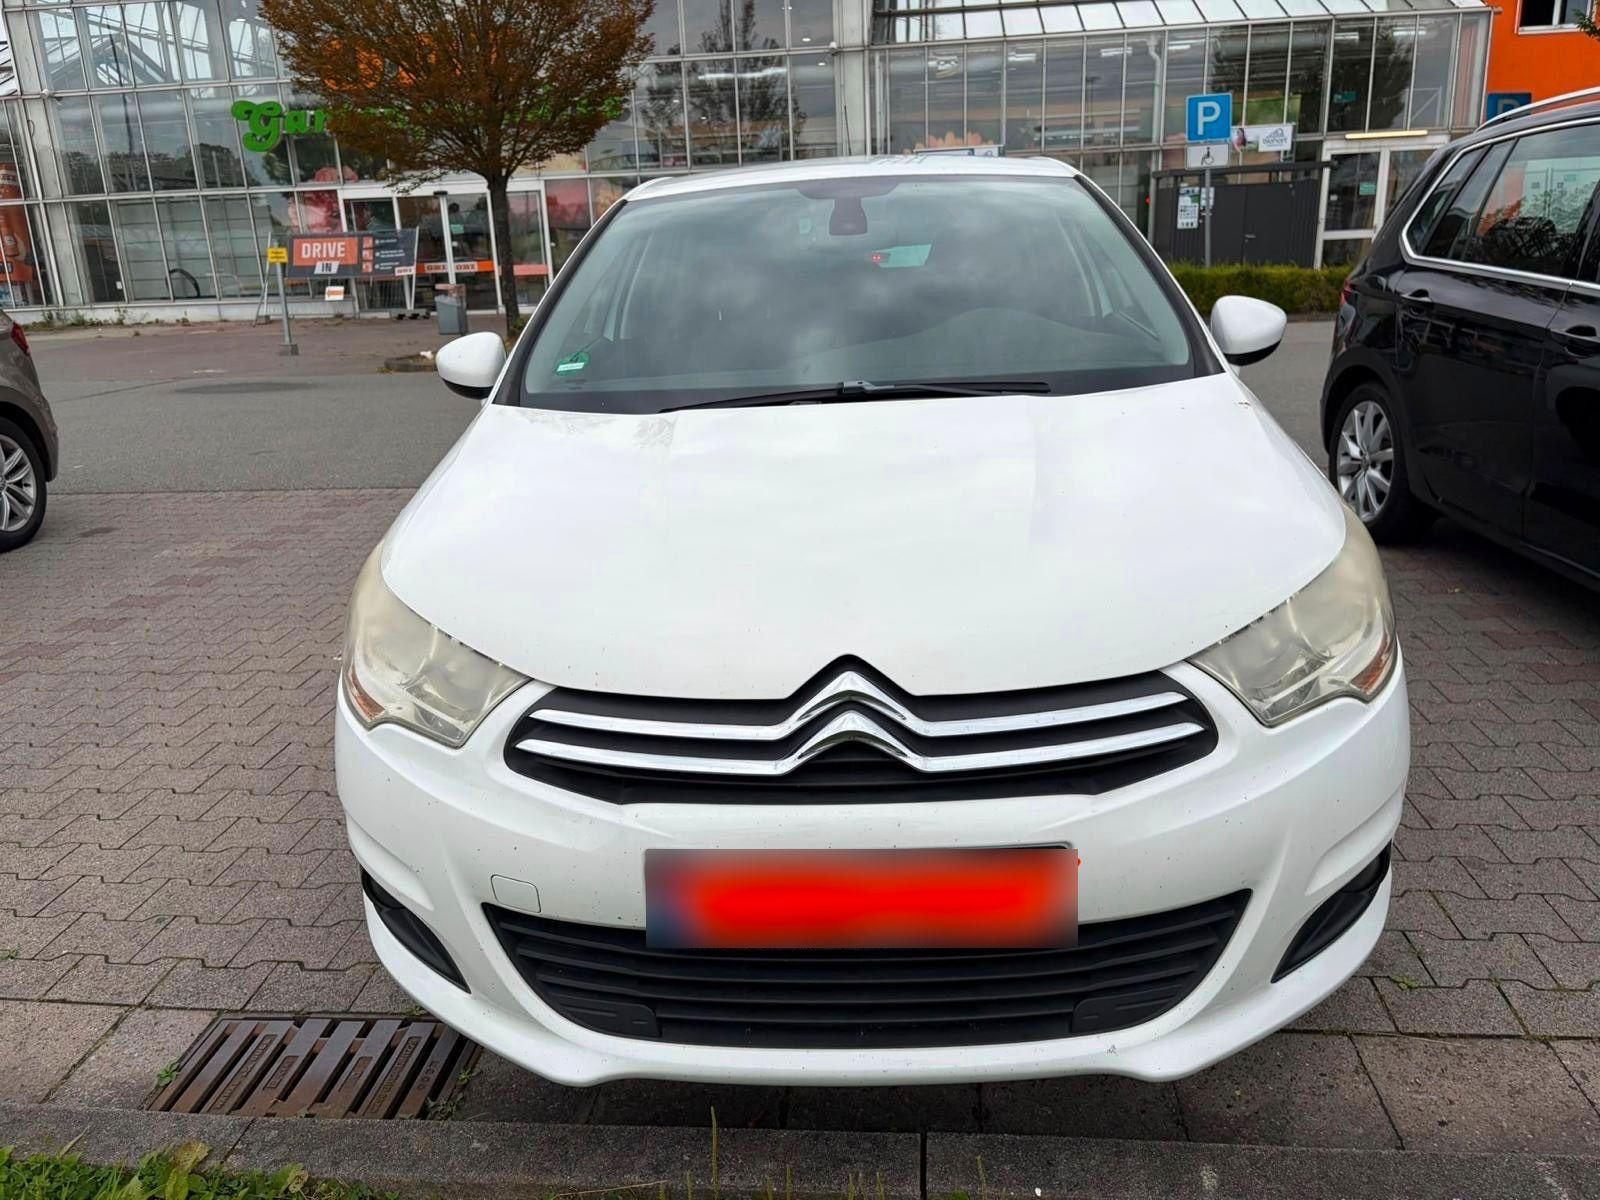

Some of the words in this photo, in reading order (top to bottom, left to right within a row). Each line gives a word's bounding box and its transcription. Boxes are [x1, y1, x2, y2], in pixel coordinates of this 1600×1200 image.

[1197, 101, 1221, 136] P
[301, 241, 346, 259] DRIVE
[321, 262, 332, 273] IN
